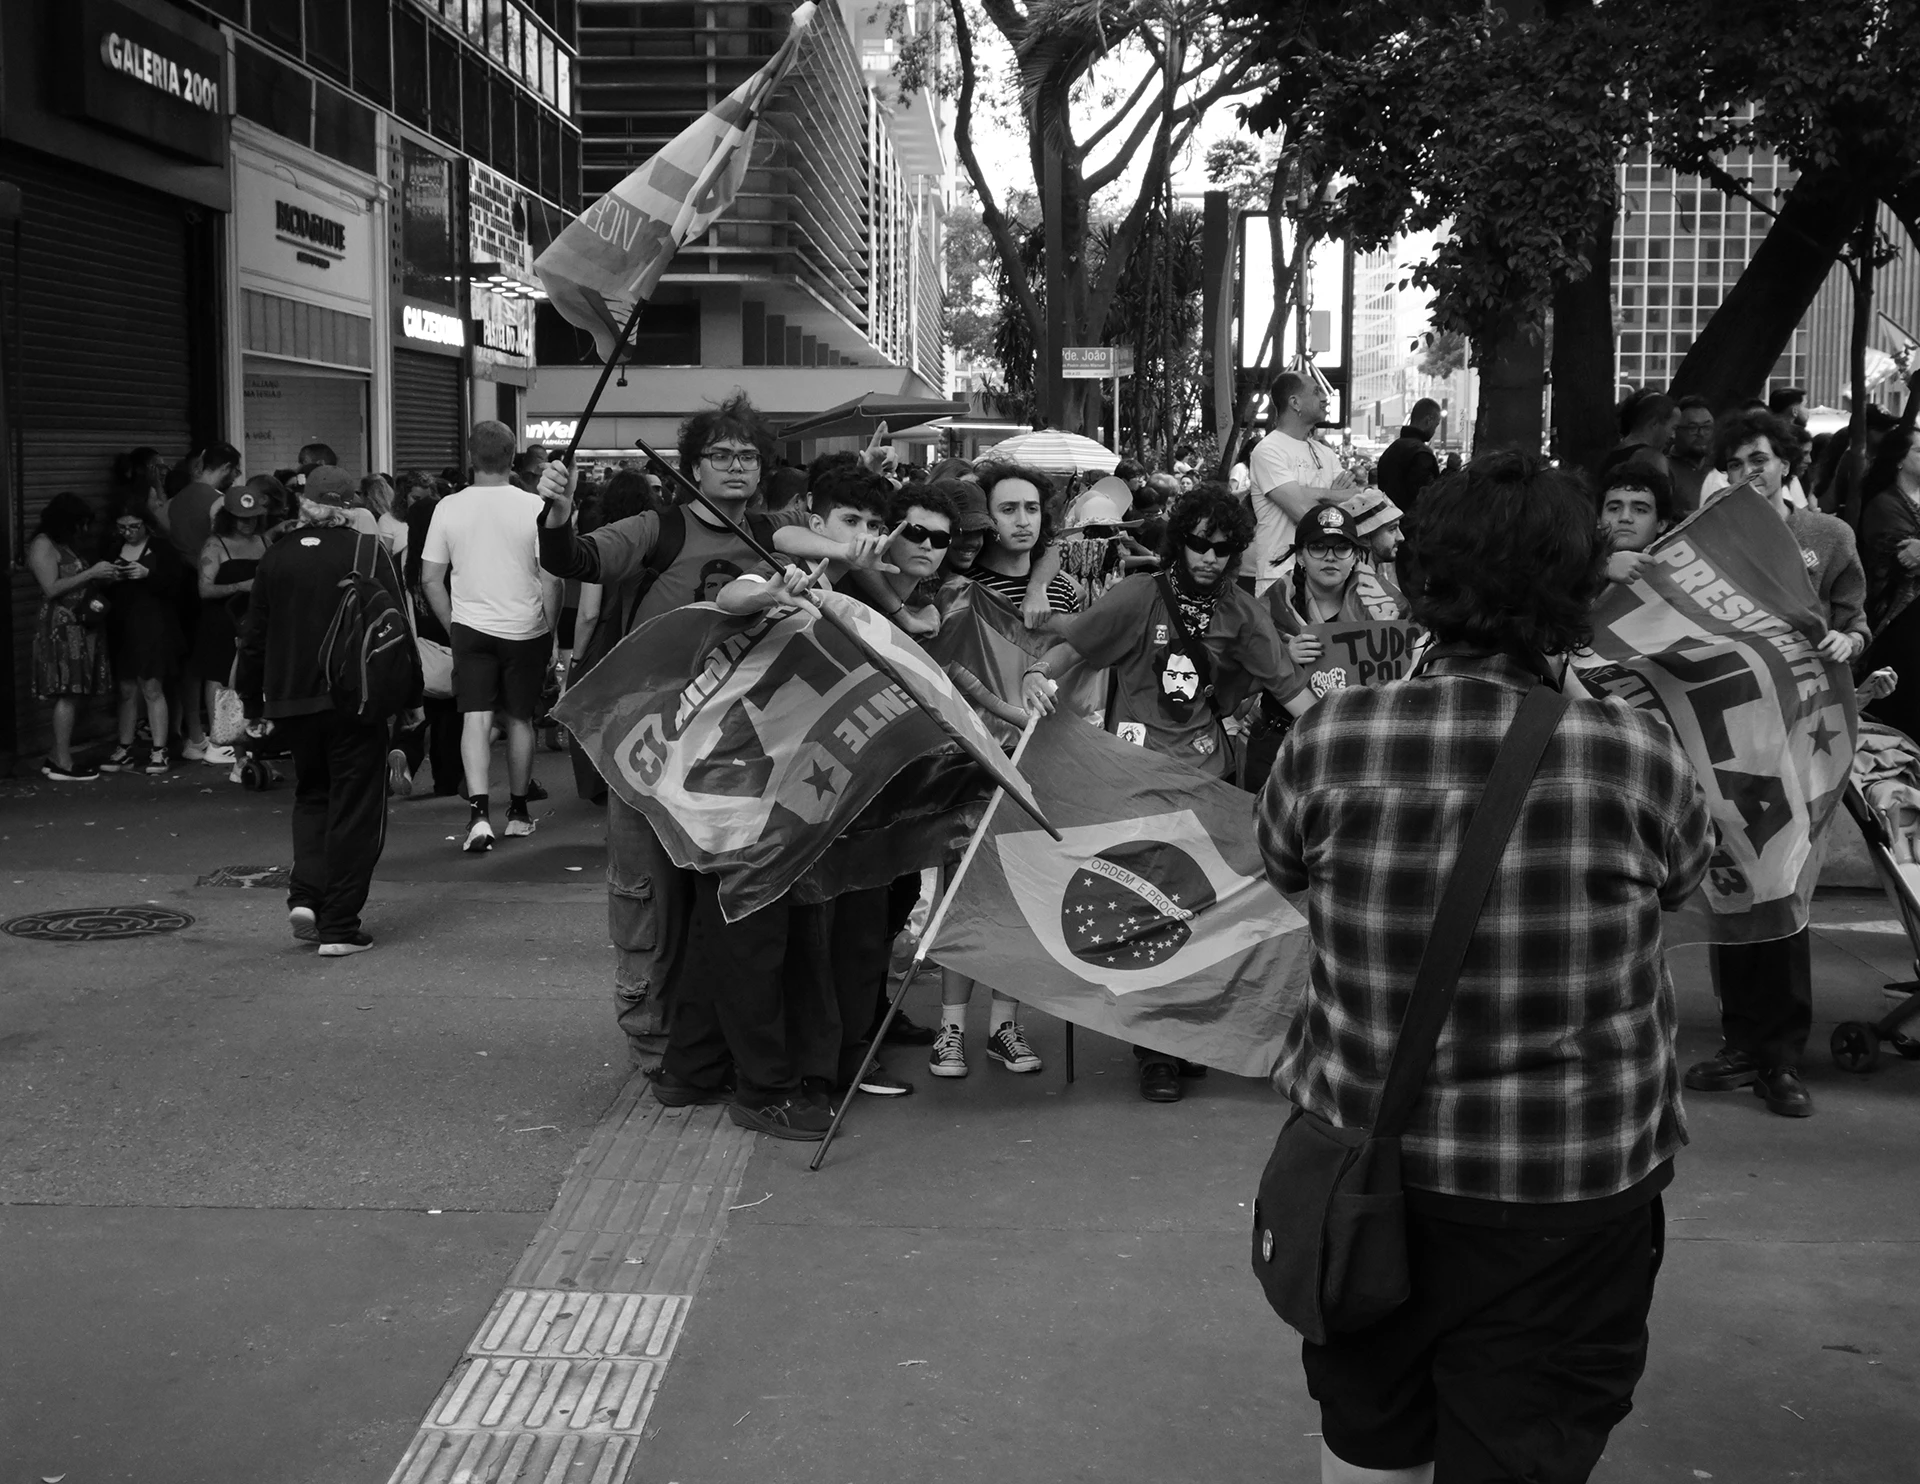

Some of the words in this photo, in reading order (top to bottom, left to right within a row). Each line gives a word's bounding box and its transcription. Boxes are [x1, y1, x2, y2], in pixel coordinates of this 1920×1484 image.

[108, 32, 180, 97] GALERIA
[183, 68, 218, 114] 2001
[1081, 350, 1107, 361] João
[1654, 540, 1830, 702] PRESIDENTE
[1311, 667, 1346, 688] PROTECT
[628, 732, 668, 787] 13
[1091, 859, 1136, 886] ORDEM
[1136, 882, 1148, 894] E
[1709, 844, 1749, 897] 13
